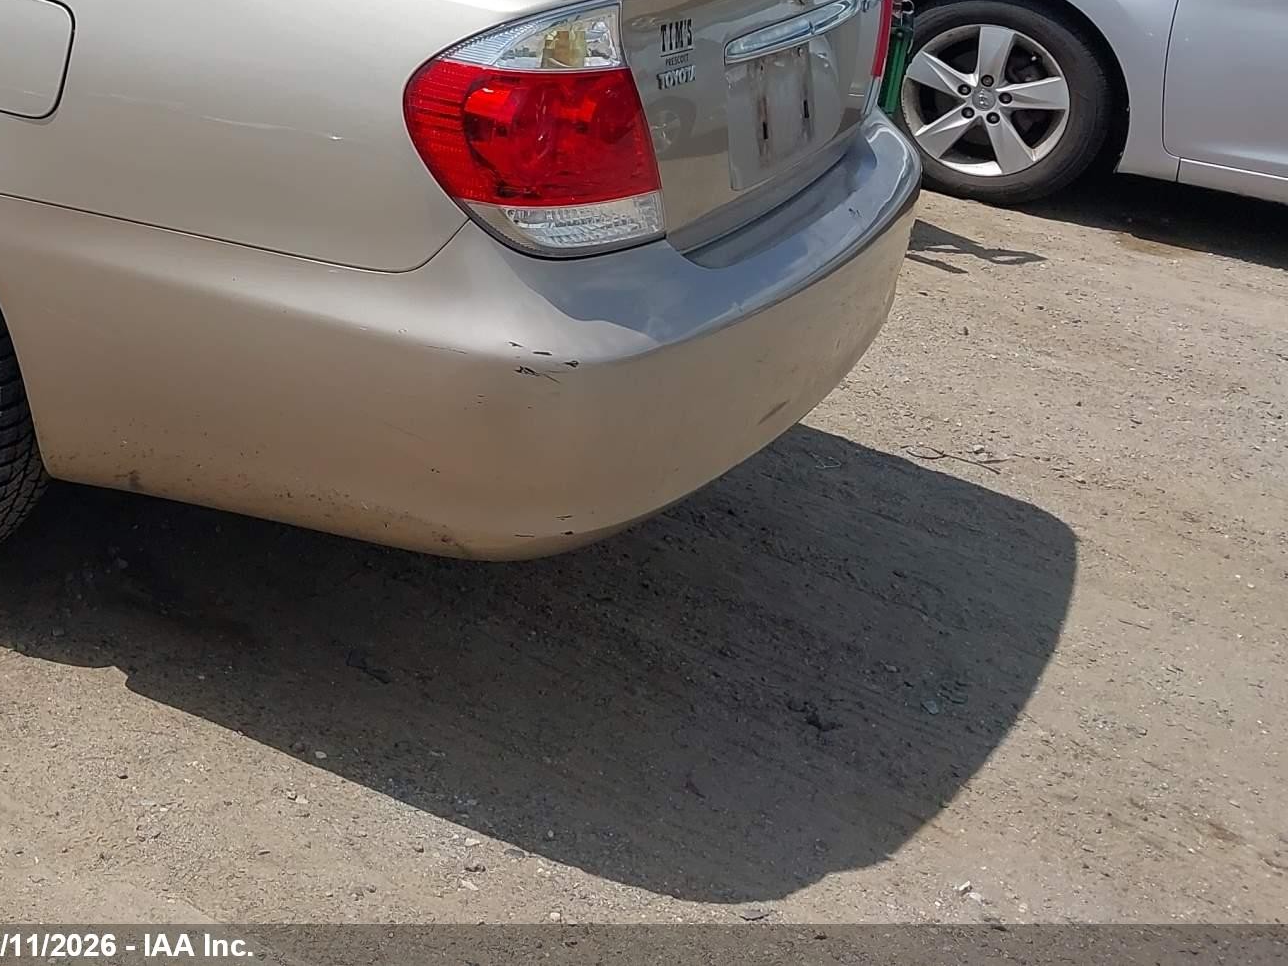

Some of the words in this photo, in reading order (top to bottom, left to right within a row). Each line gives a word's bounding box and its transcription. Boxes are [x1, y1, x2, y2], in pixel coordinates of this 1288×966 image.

[660, 18, 693, 52] TIM'S
[665, 53, 689, 66] PRESCOTT
[656, 65, 696, 90] TOYOTA
